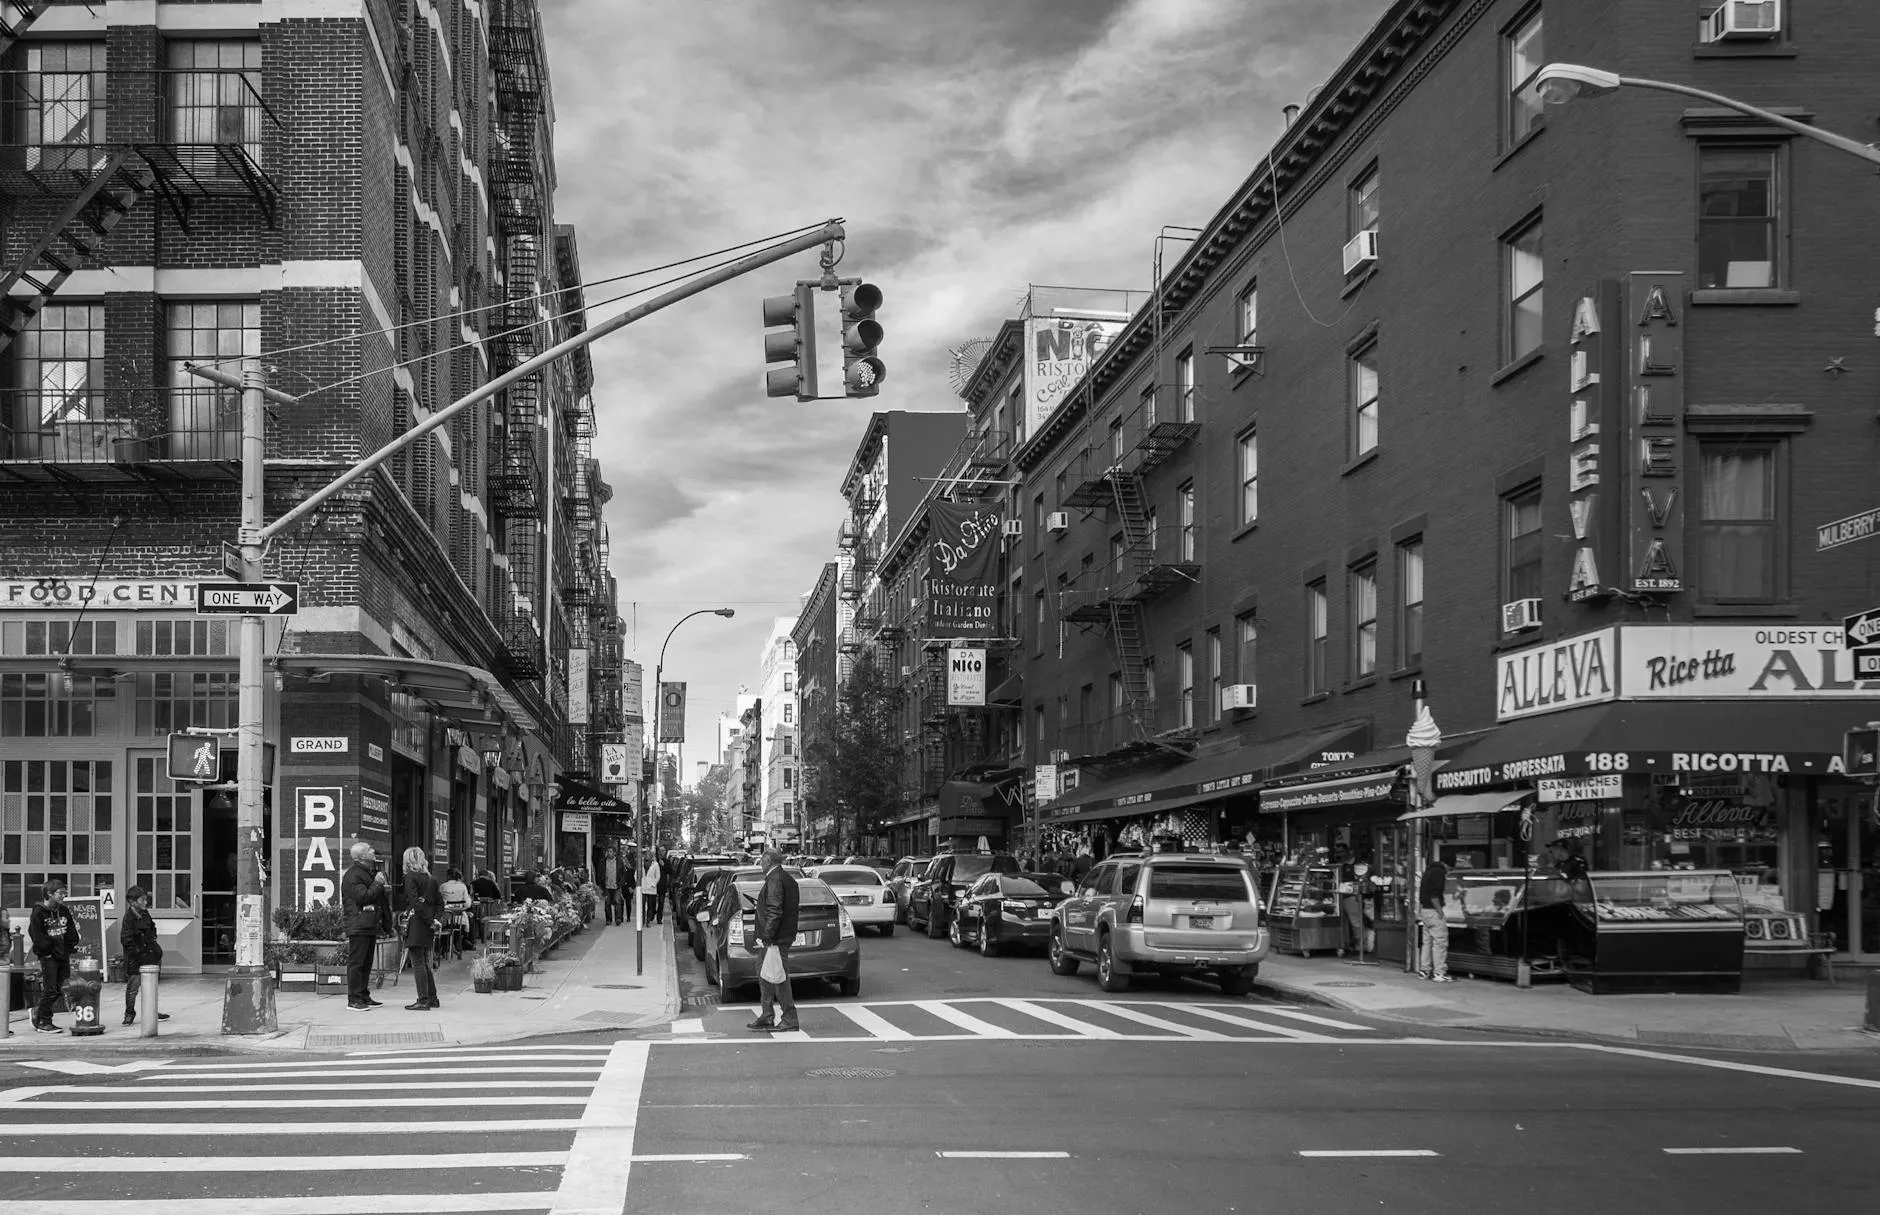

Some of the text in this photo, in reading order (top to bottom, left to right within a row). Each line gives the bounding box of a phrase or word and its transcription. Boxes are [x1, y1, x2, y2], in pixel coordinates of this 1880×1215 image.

[1637, 284, 1678, 579] ALLEVA
[1570, 296, 1600, 591] ALLEVA
[1818, 512, 1877, 548] MULBERRY
[932, 510, 999, 575] Da Nico
[931, 579, 996, 597] Ristorante
[1658, 579, 1680, 588] 1892
[8, 585, 197, 601] FOOD CENT
[212, 592, 283, 605] ONE WAY
[933, 600, 991, 618] Italiano
[1755, 631, 1818, 645] OLDEST
[960, 651, 975, 659] DA
[952, 659, 982, 672] NICO
[1646, 648, 1737, 691] Ricotta
[1500, 637, 1611, 714] ALLEVA
[296, 739, 343, 750] GRAND
[1321, 751, 1355, 761] TONY'S
[1585, 752, 1630, 771] 188
[1672, 752, 1790, 773] RICOTTA
[1436, 754, 1566, 790] PROSCIUTTO SOPRESSATA
[1541, 776, 1620, 791] SANDWICHES
[566, 796, 577, 806] la
[578, 796, 600, 806] bella
[1556, 788, 1605, 800] PANINI
[1672, 799, 1756, 824] Alleva
[435, 818, 448, 842] BAR
[1673, 828, 1701, 839] BEST
[302, 795, 335, 913] BAR
[103, 892, 114, 905] A
[73, 904, 97, 913] NEVER
[77, 911, 98, 920] AGAIN
[75, 1005, 95, 1022] 36
